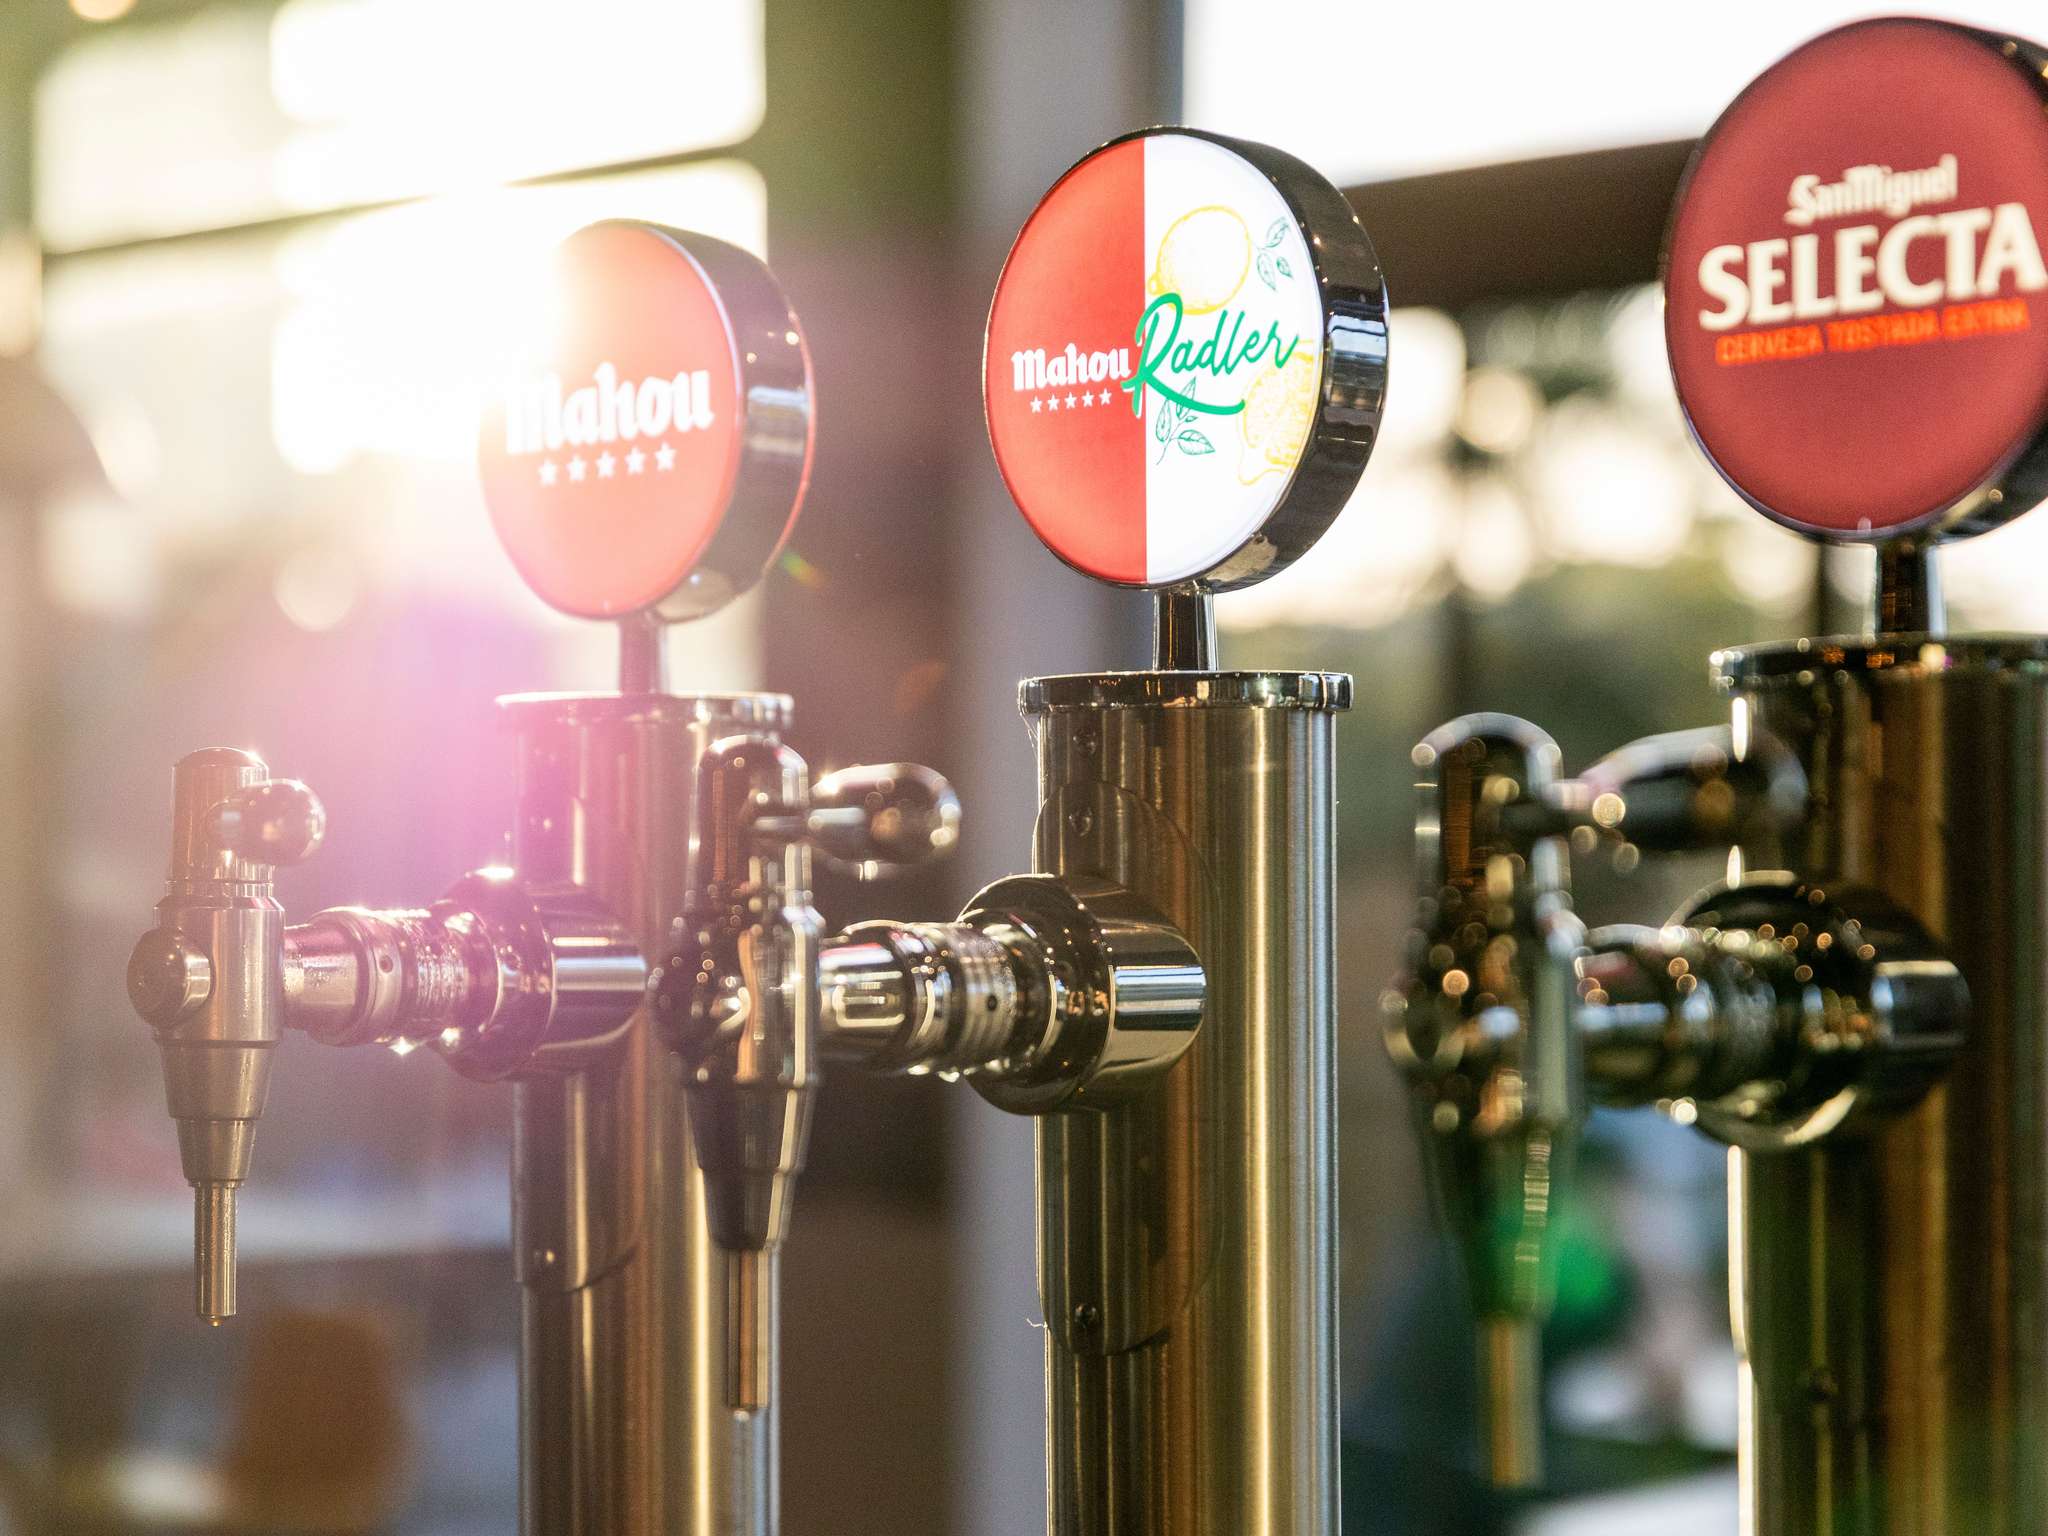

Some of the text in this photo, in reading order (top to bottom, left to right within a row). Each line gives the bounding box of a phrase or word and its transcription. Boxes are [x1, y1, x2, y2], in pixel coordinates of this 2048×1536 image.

[1698, 202, 2047, 331] SELECTA
[506, 361, 714, 454] Mahou
[1011, 343, 1131, 391] Mahou
[1120, 293, 1299, 418] Radler
